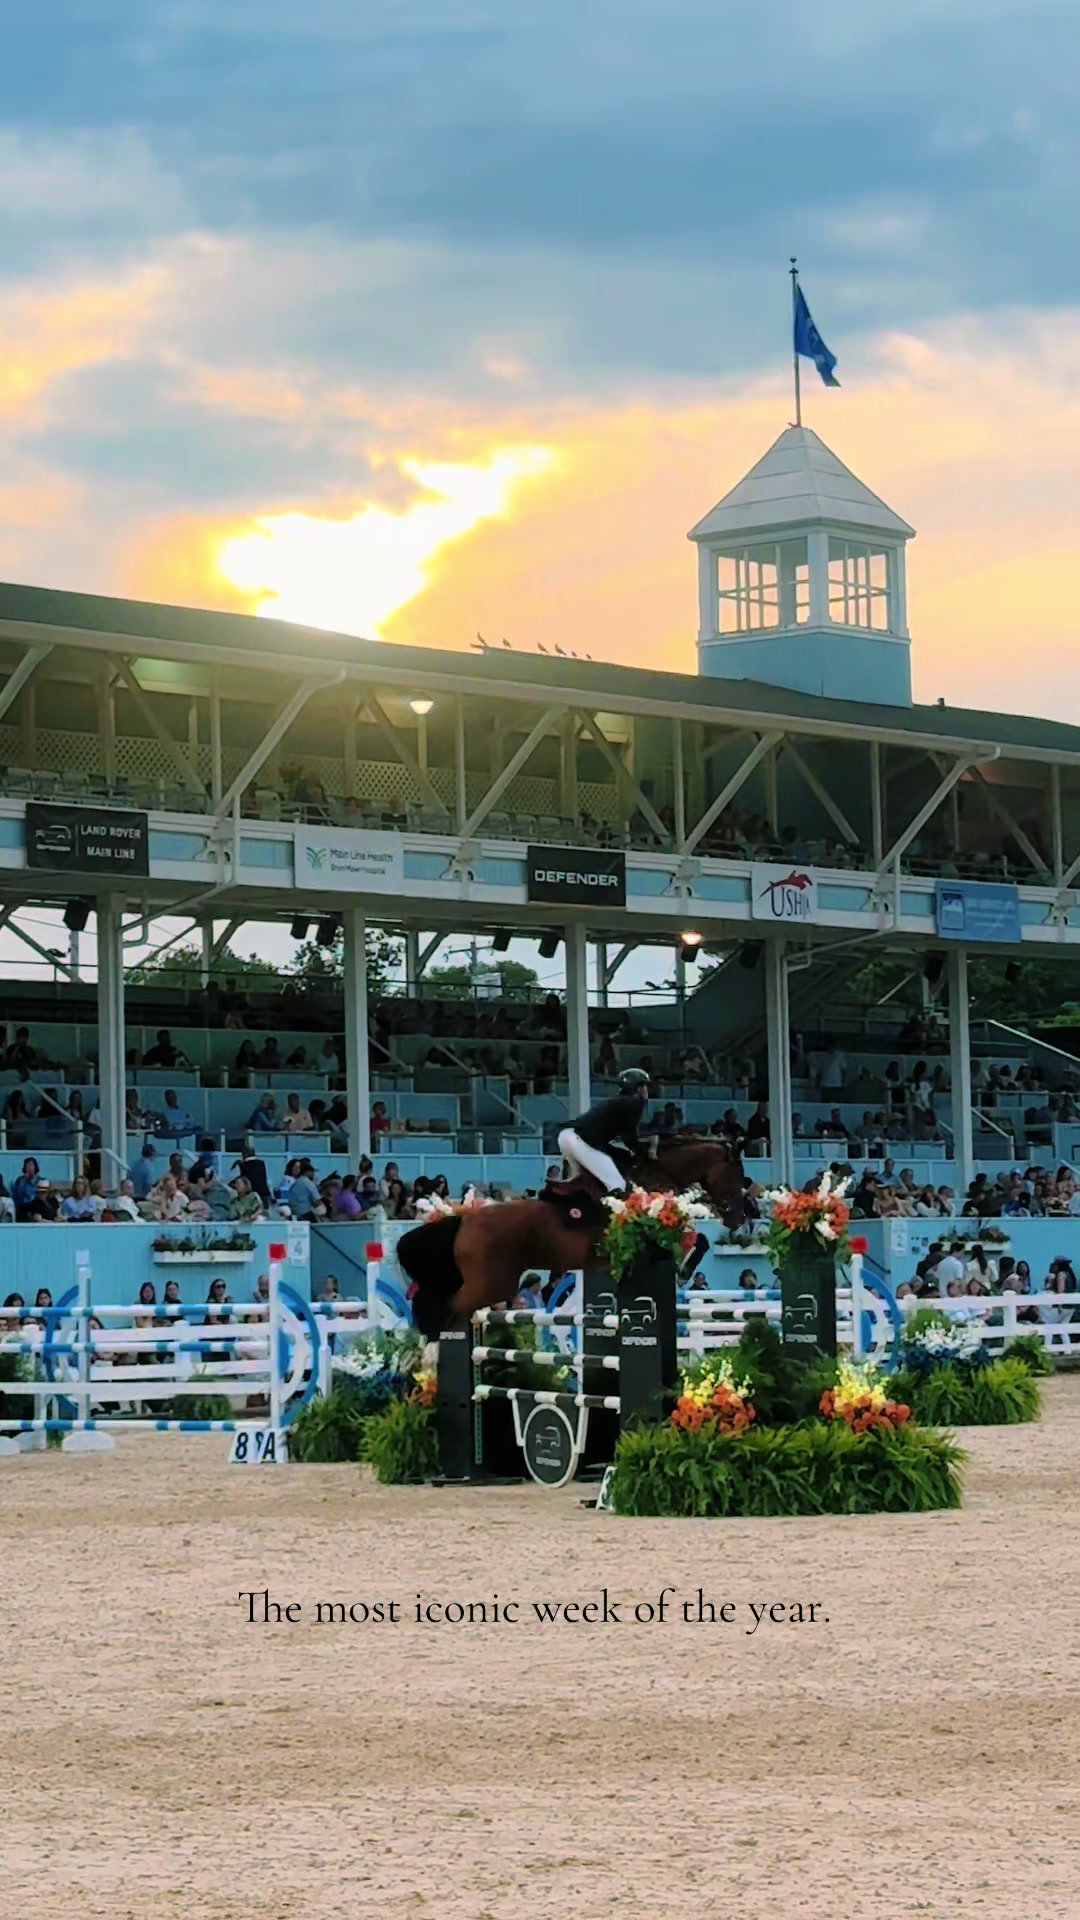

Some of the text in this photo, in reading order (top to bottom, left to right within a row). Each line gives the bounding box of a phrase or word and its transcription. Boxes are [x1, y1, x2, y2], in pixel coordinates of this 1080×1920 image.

[81, 824, 141, 839] LAND ROVER
[87, 845, 136, 859] MAIN LINE
[534, 869, 619, 887] DEFENDER
[235, 1431, 249, 1460] 8
